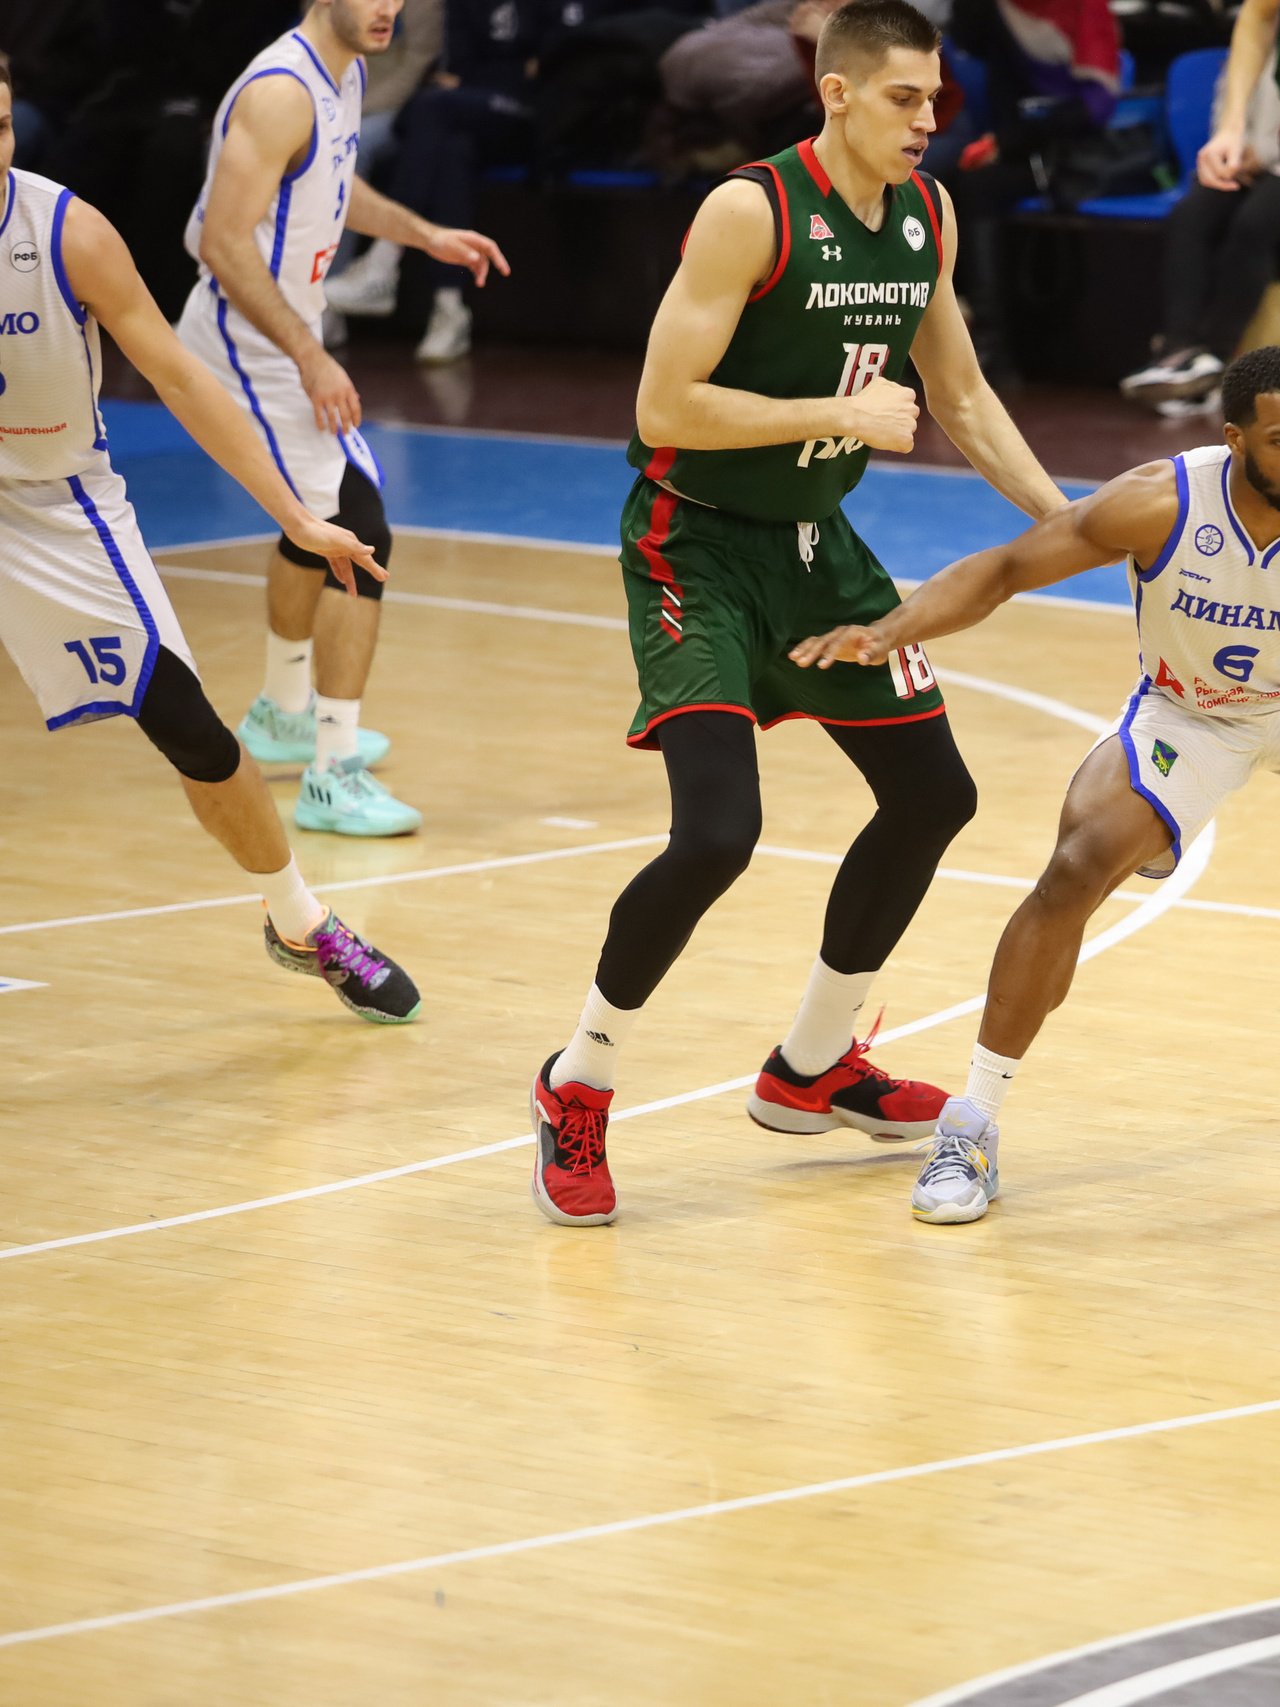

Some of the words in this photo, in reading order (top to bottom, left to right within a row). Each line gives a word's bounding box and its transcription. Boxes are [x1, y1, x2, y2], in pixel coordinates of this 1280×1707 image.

[14, 251, 38, 262] РФБ
[805, 281, 930, 310] ЛОКОМОТИВ
[843, 314, 902, 326] КУБАНЬ
[835, 342, 891, 397] 18
[64, 636, 126, 687] 15
[888, 642, 937, 699] 18
[1212, 644, 1261, 683] 6
